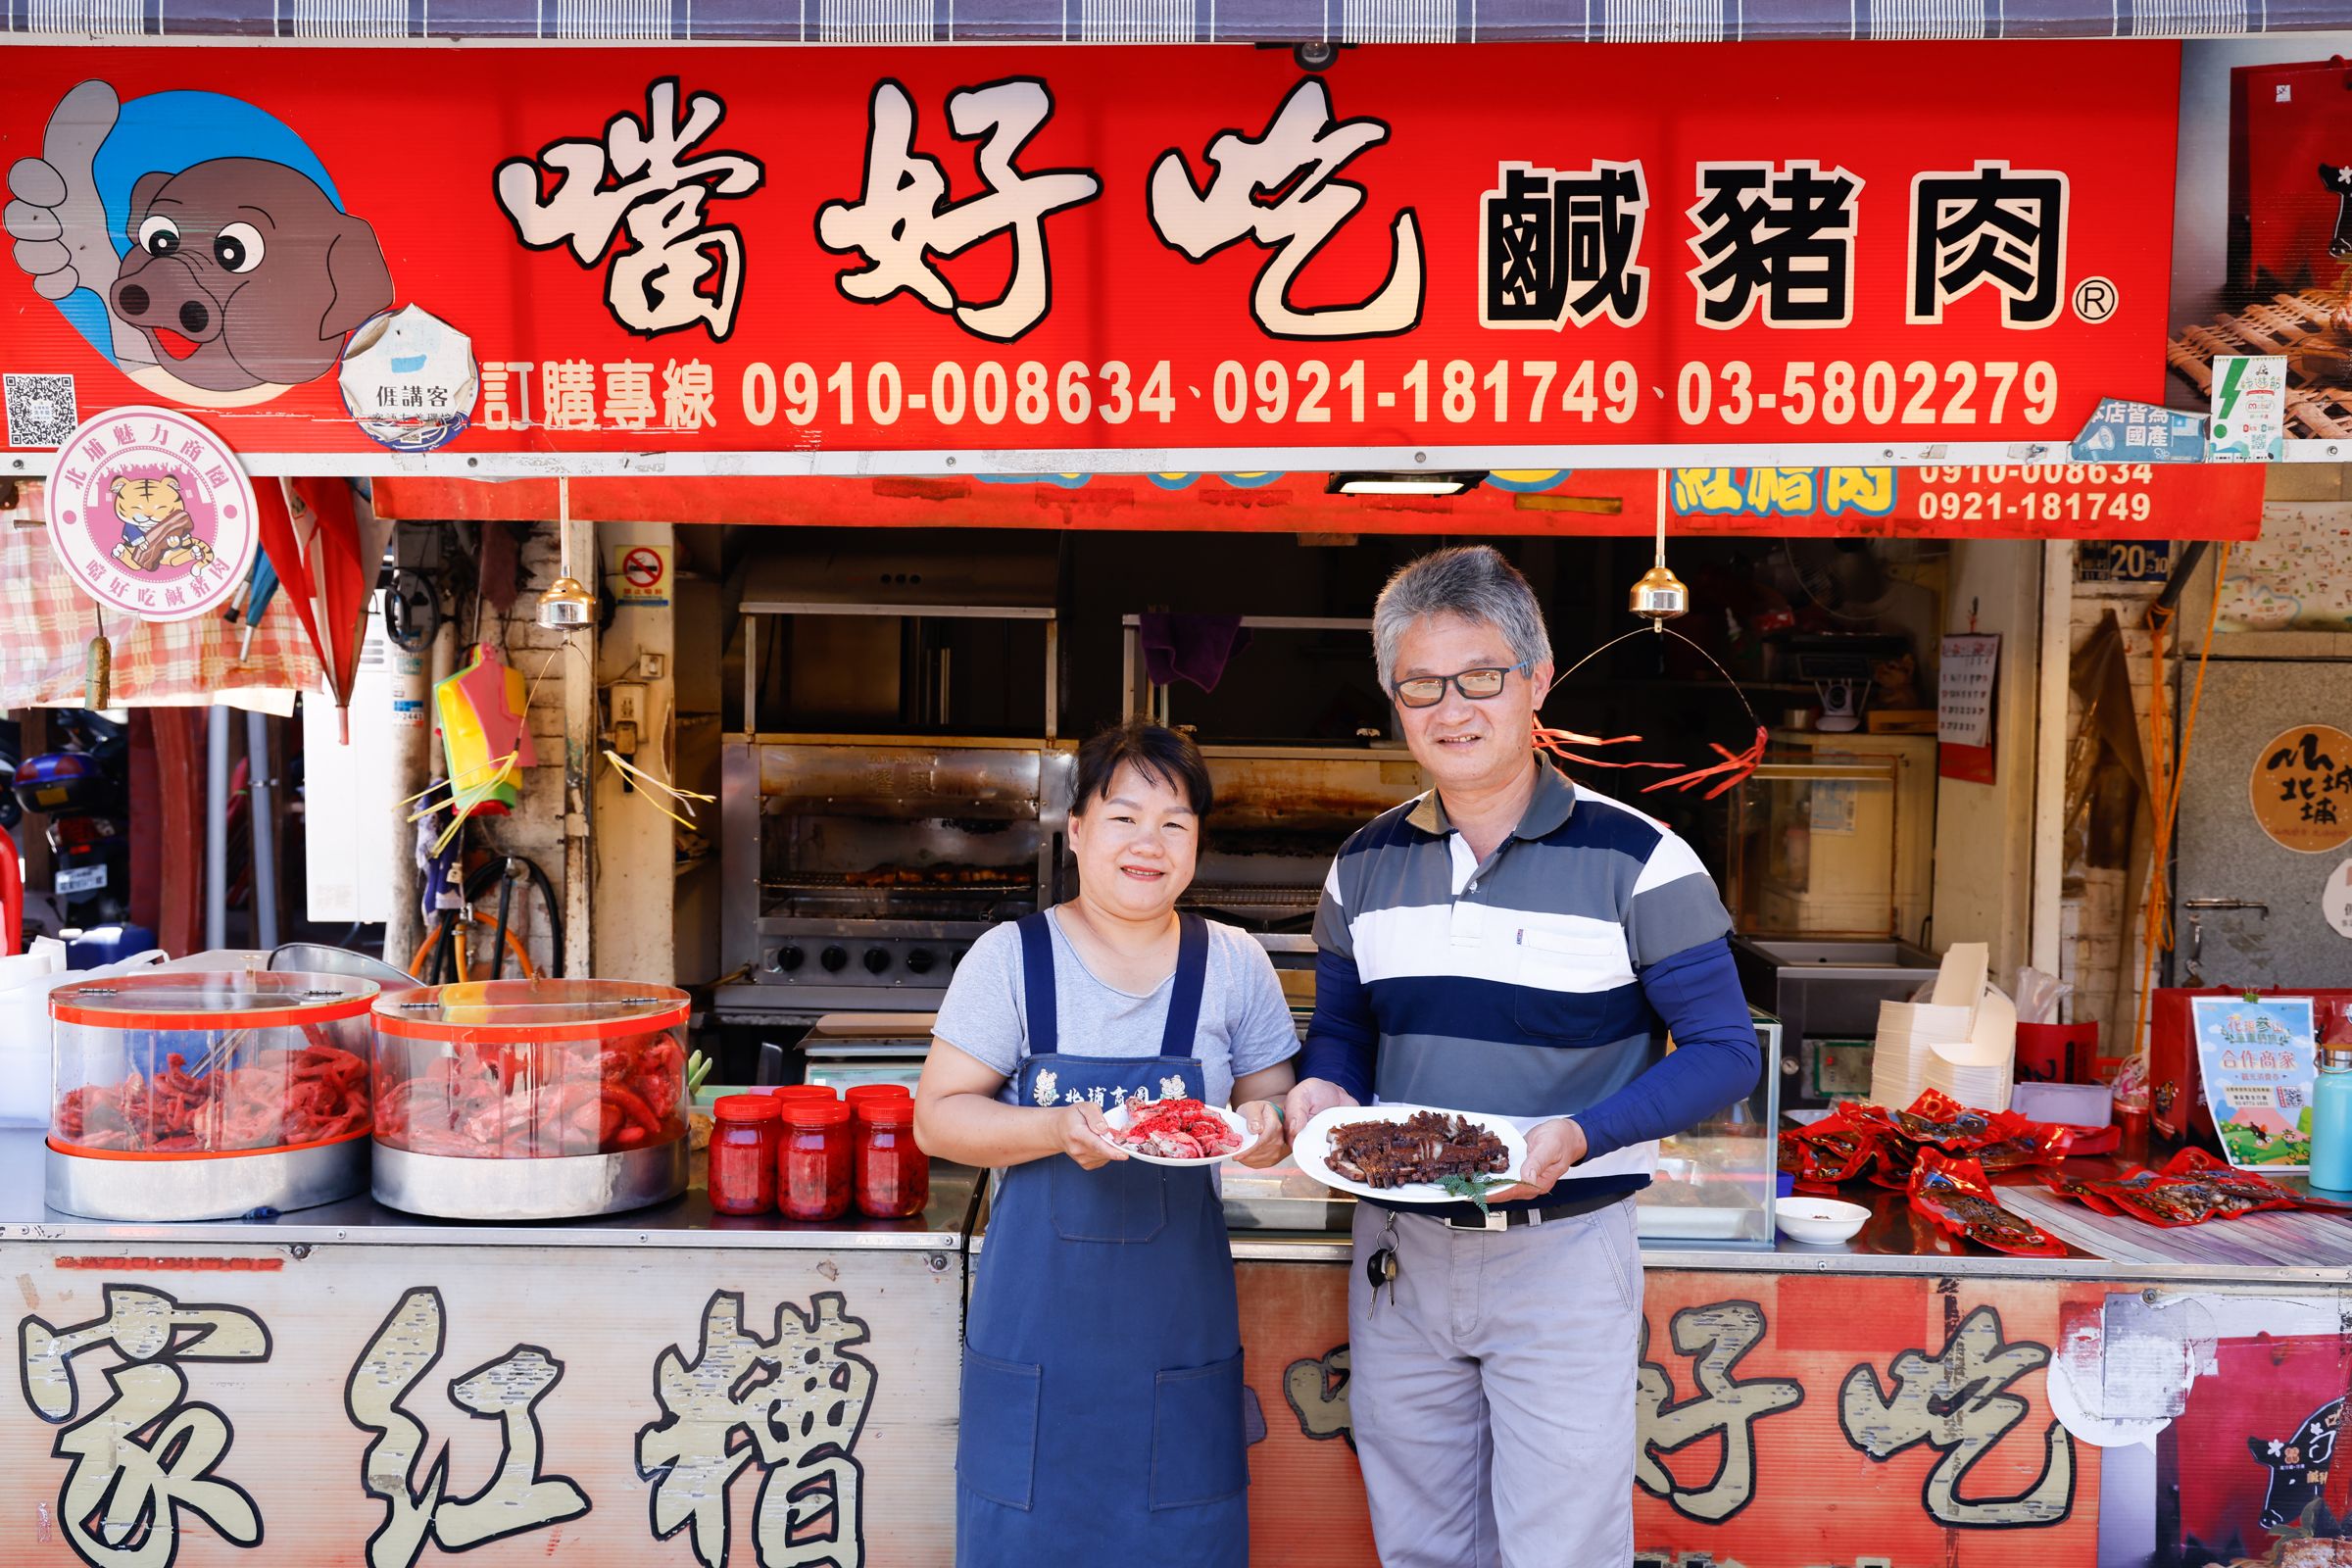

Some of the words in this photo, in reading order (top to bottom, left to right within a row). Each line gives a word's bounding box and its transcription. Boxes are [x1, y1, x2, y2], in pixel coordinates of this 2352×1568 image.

[481, 359, 716, 431] 訂購專線
[2125, 425, 2168, 448] 國產
[1918, 465, 2154, 485] 0910-008634
[1918, 491, 2152, 521] 0921-181749
[2223, 1050, 2296, 1069] 合作商家
[1284, 1299, 2073, 1527] 好吃
